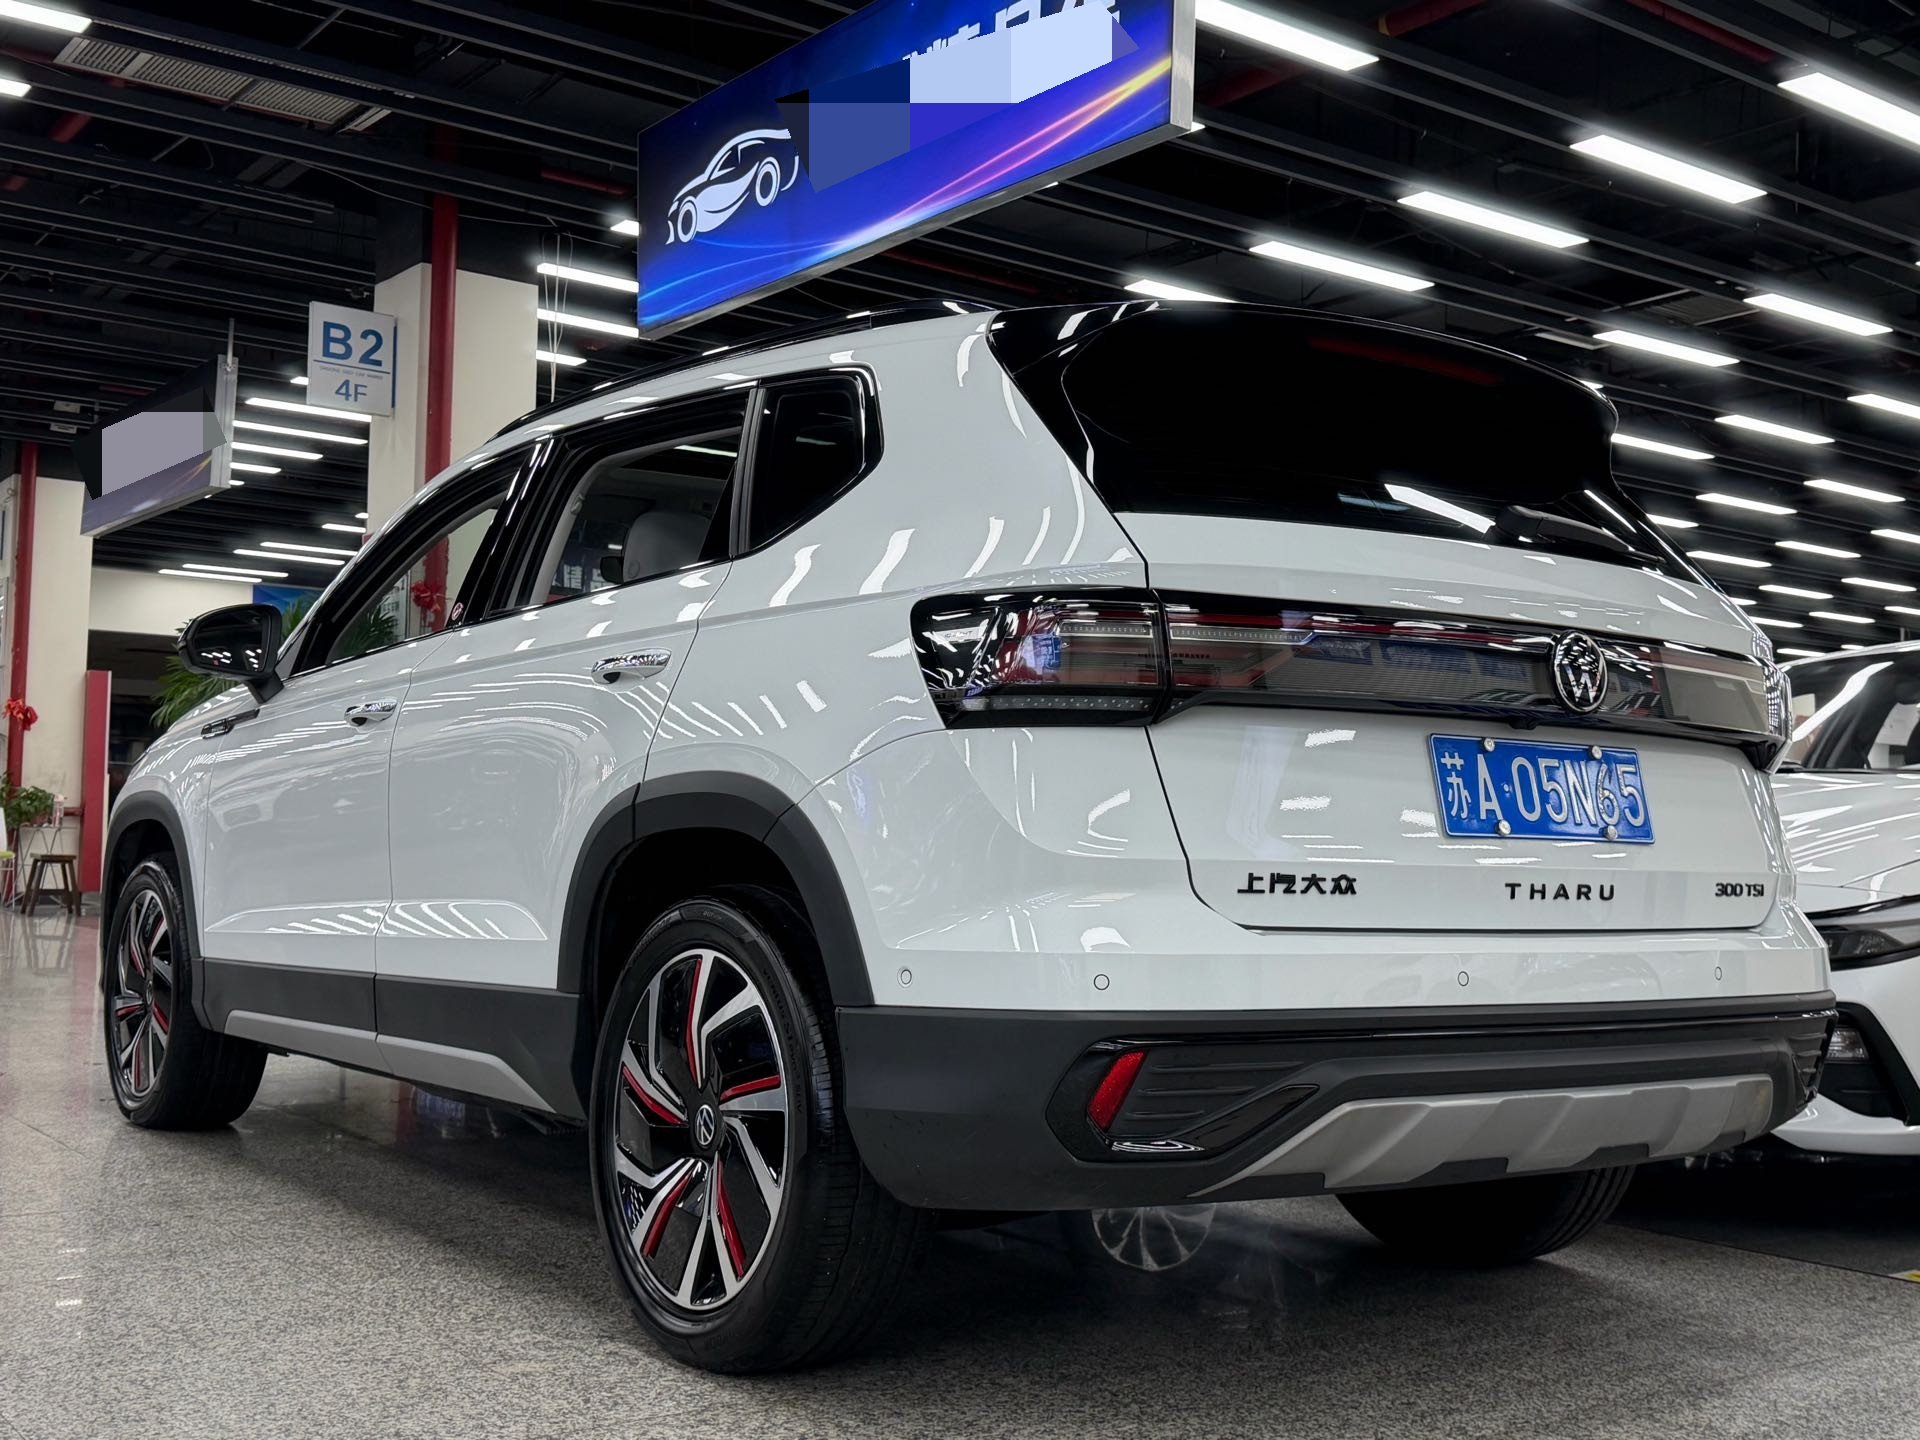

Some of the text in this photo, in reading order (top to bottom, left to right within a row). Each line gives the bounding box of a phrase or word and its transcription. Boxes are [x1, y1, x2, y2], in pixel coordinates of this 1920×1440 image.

[322, 321, 384, 368] B2
[334, 379, 369, 402] 4F
[1237, 872, 1357, 895] 上汽大众
[1504, 883, 1615, 901] THARU
